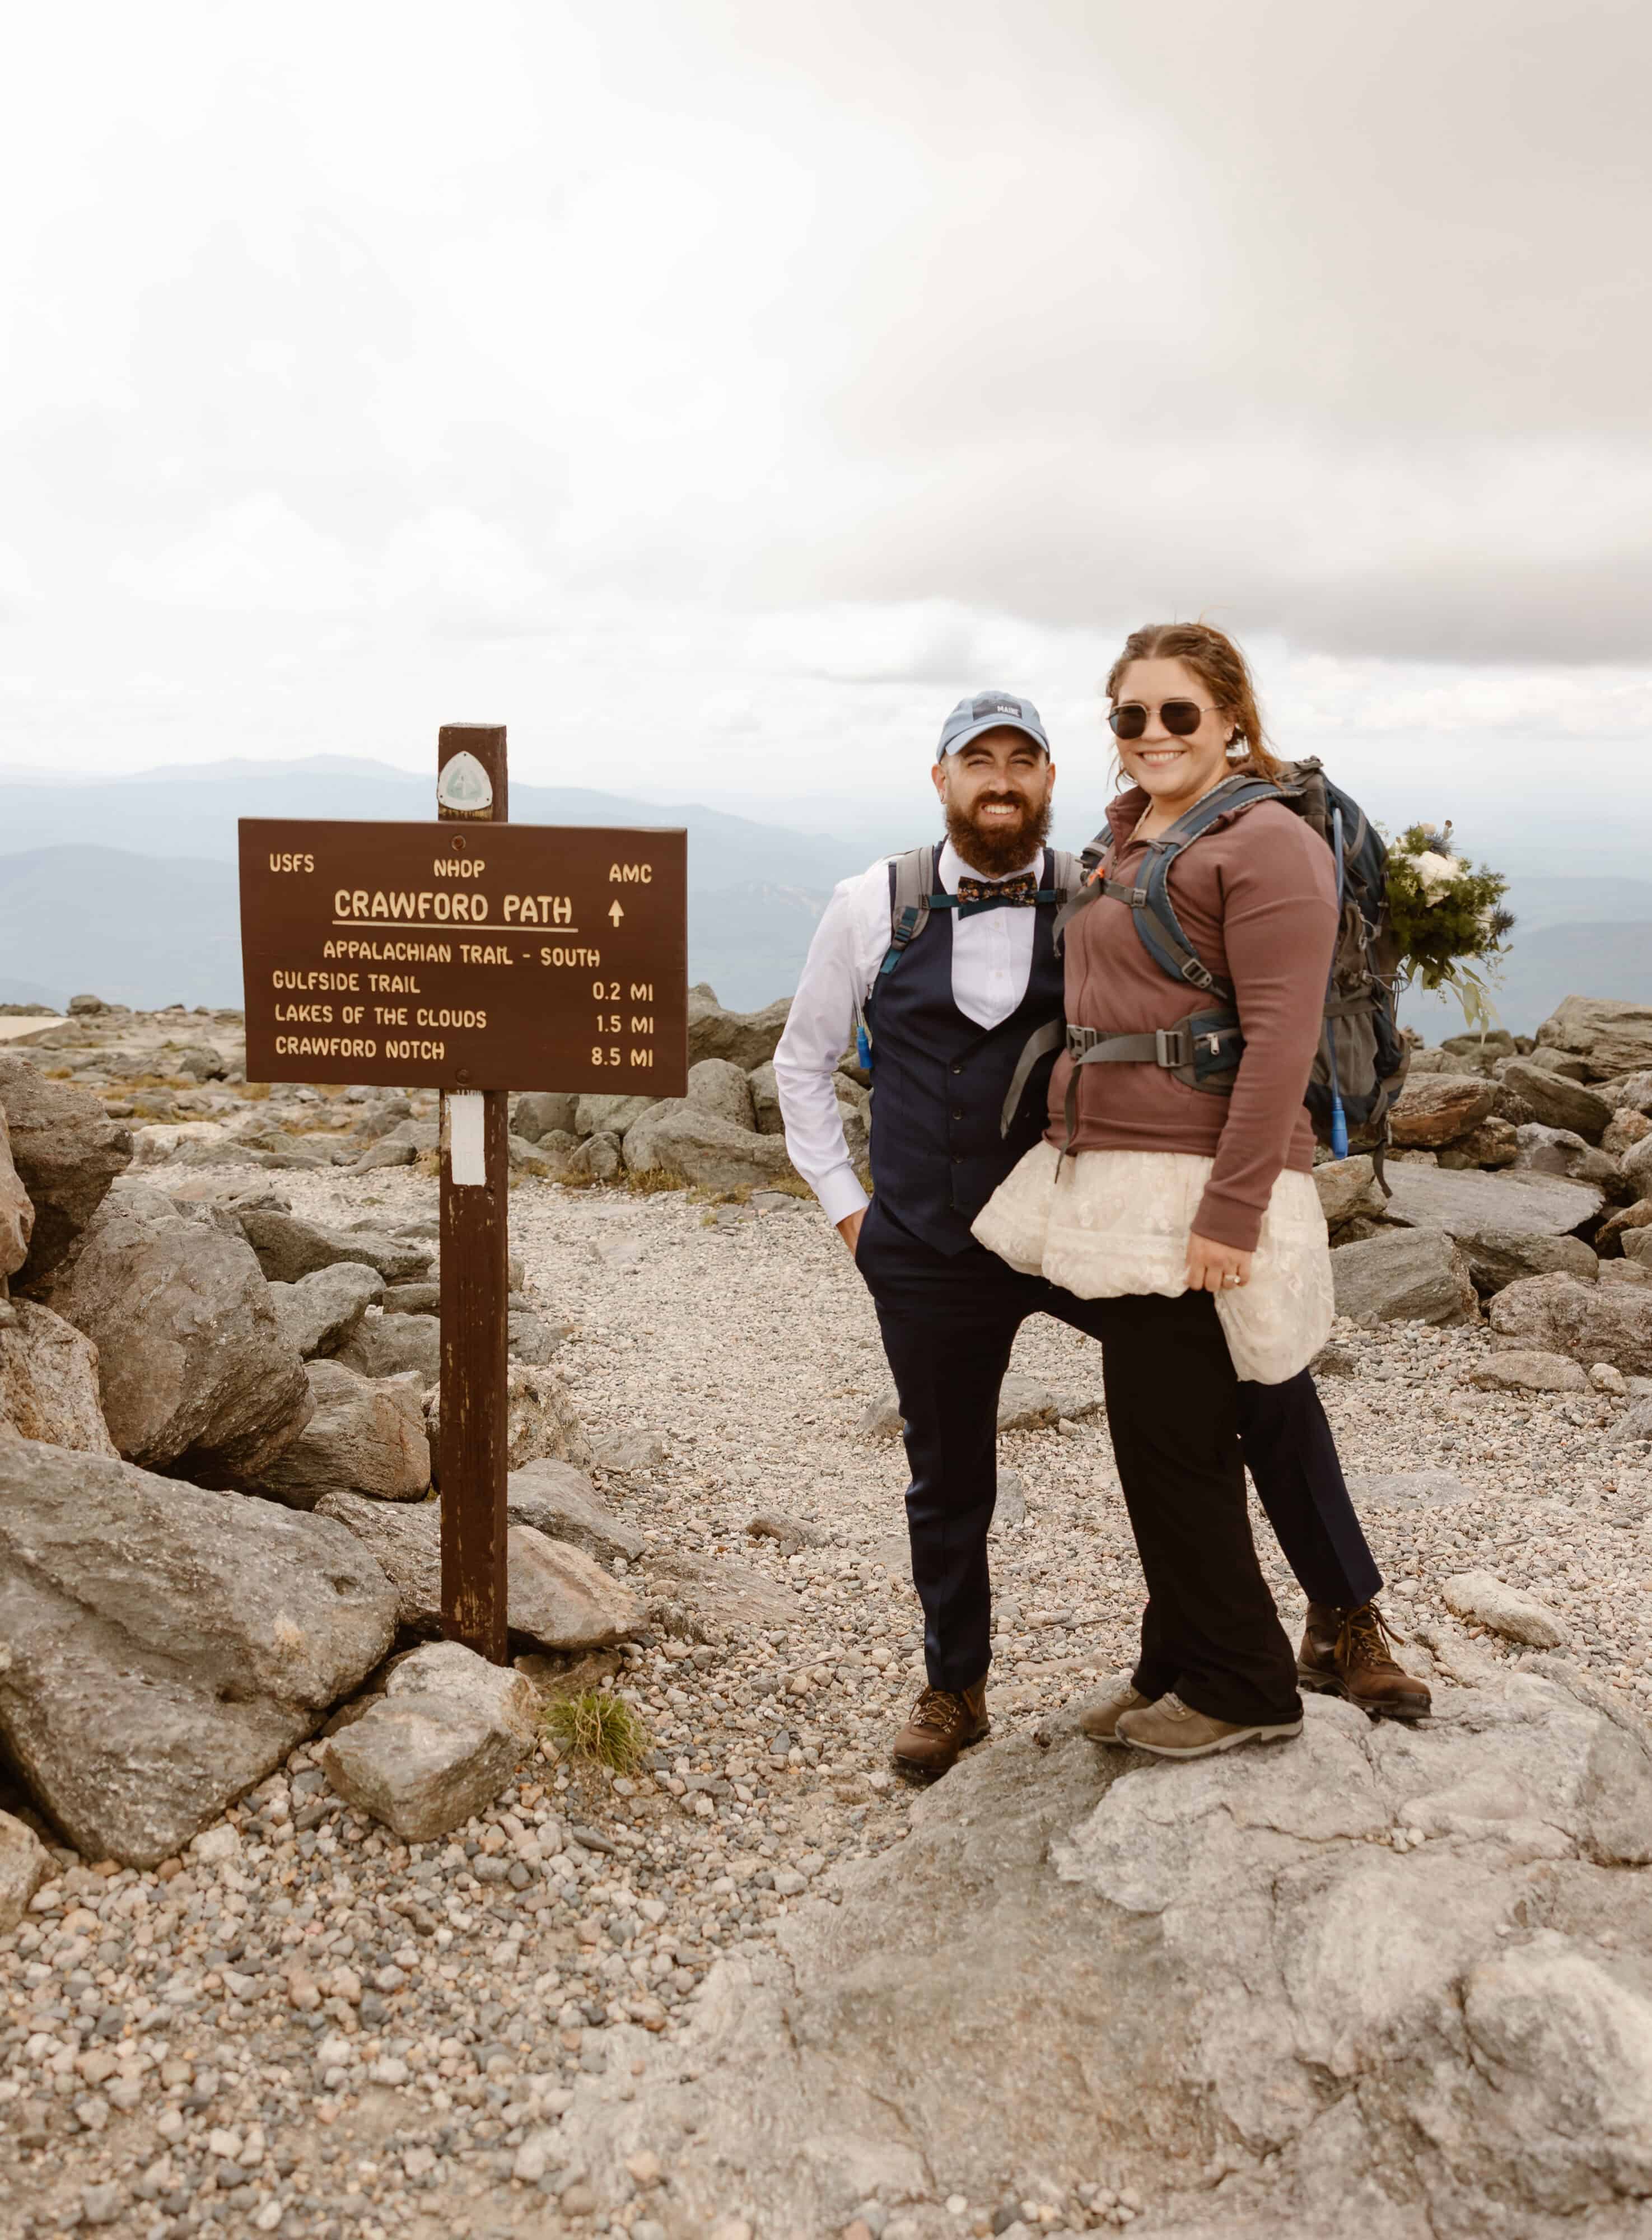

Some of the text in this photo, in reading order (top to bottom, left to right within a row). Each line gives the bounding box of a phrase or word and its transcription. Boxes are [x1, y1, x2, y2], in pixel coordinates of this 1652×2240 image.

[270, 853, 314, 872] USFS
[433, 859, 485, 878] NHDP
[609, 864, 652, 883] AMC
[334, 889, 572, 923] CRAWFORD PATH
[324, 940, 451, 963] APPALACHIAN
[459, 945, 513, 965] TRAIL
[540, 947, 600, 967] SOUTH
[273, 970, 653, 1001] GULFSIDE TRAIL 0.2 MI
[275, 1004, 654, 1034] LAKES OF THE CLOUDS 1.5 MI
[276, 1036, 653, 1067] CRAWFORD NOTCH 8.5 MI
